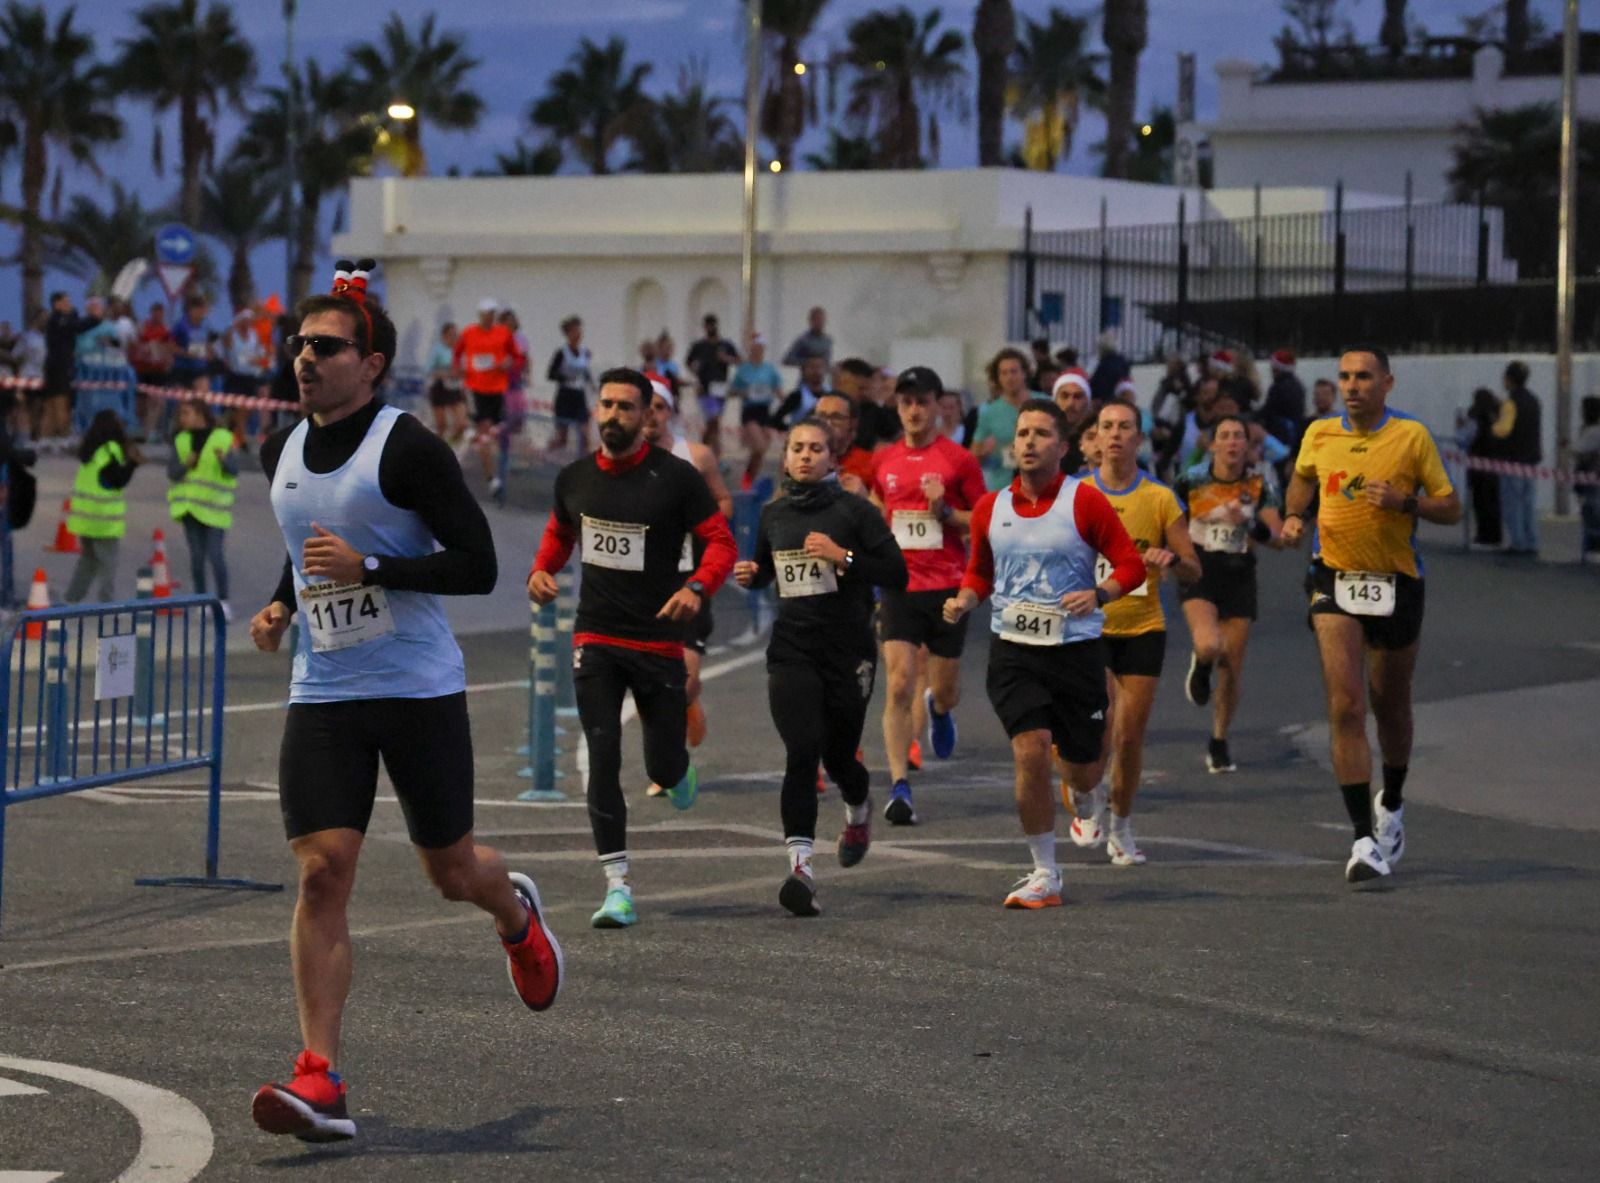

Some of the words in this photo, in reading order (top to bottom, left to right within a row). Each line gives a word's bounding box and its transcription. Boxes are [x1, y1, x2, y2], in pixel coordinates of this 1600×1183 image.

[907, 522, 927, 537] 10
[593, 533, 631, 556] 203
[784, 561, 823, 583] 874
[1347, 584, 1382, 602] 143
[311, 592, 380, 631] 1174
[1015, 613, 1052, 636] 841
